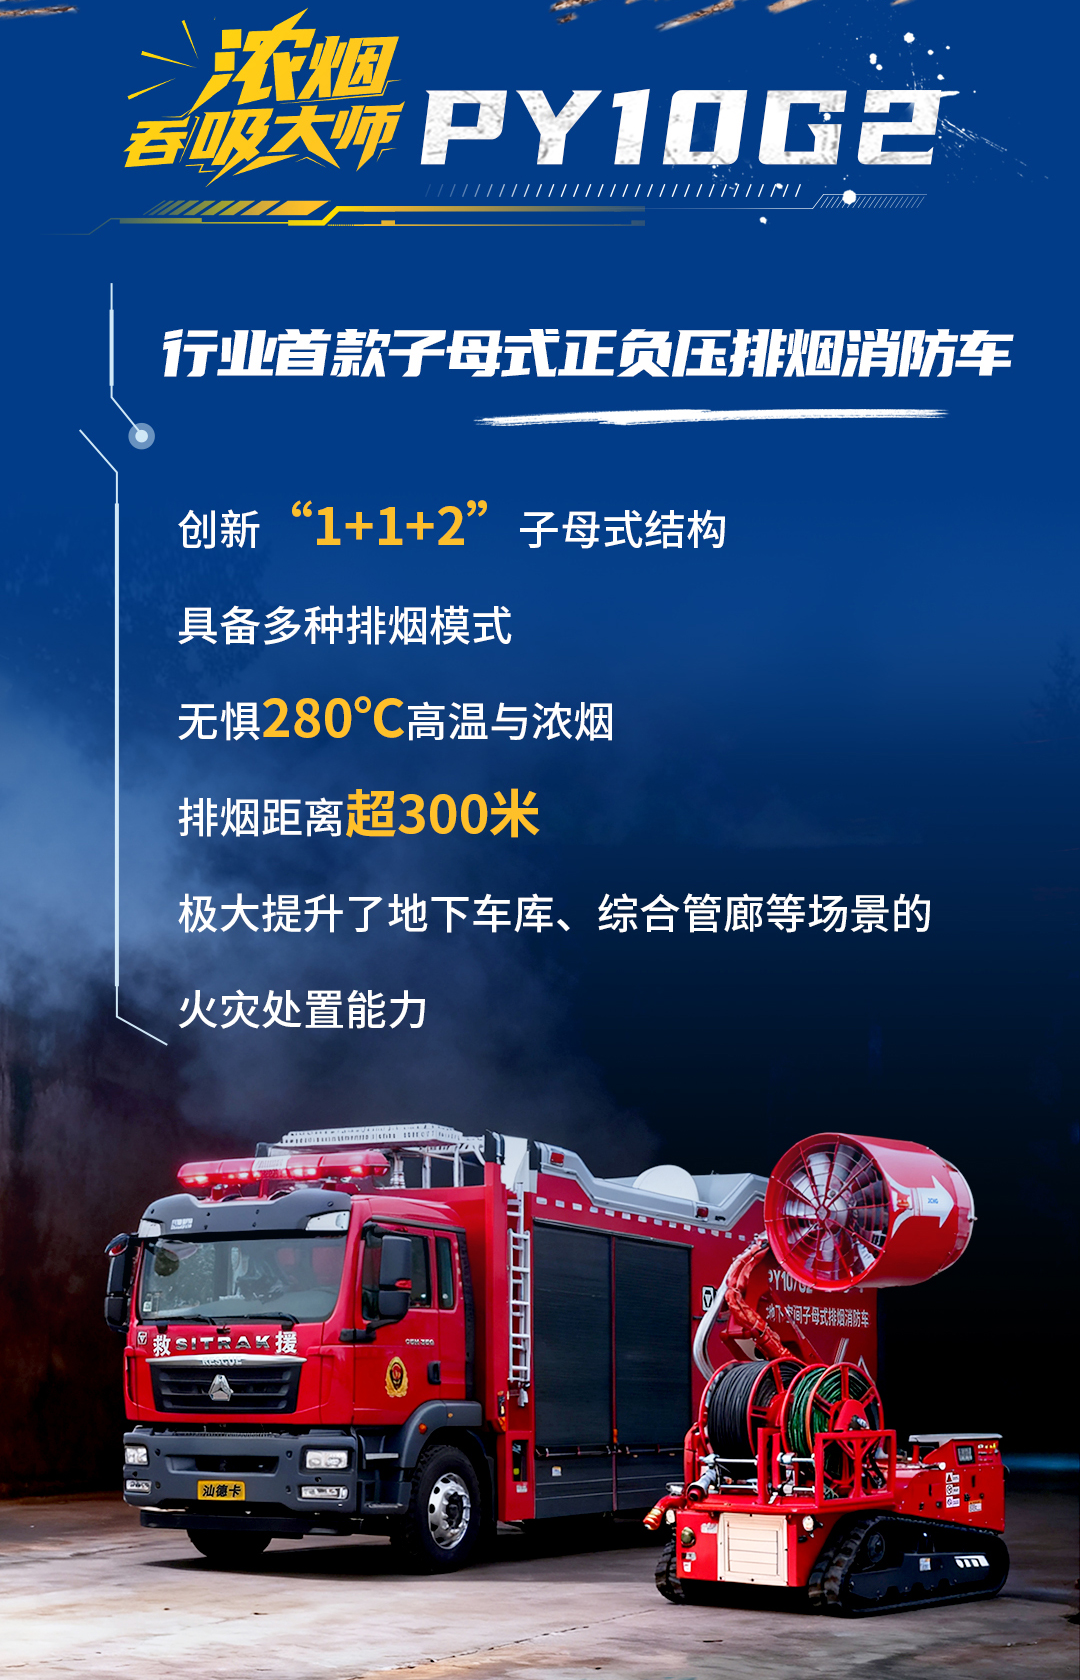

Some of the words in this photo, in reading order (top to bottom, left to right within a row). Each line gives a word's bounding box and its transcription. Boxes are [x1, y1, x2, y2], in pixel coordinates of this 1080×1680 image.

[153, 1334, 171, 1357] 救
[175, 1335, 270, 1351] SITRAK
[275, 1331, 297, 1354] 援
[202, 1484, 241, 1498] 汕德卡
